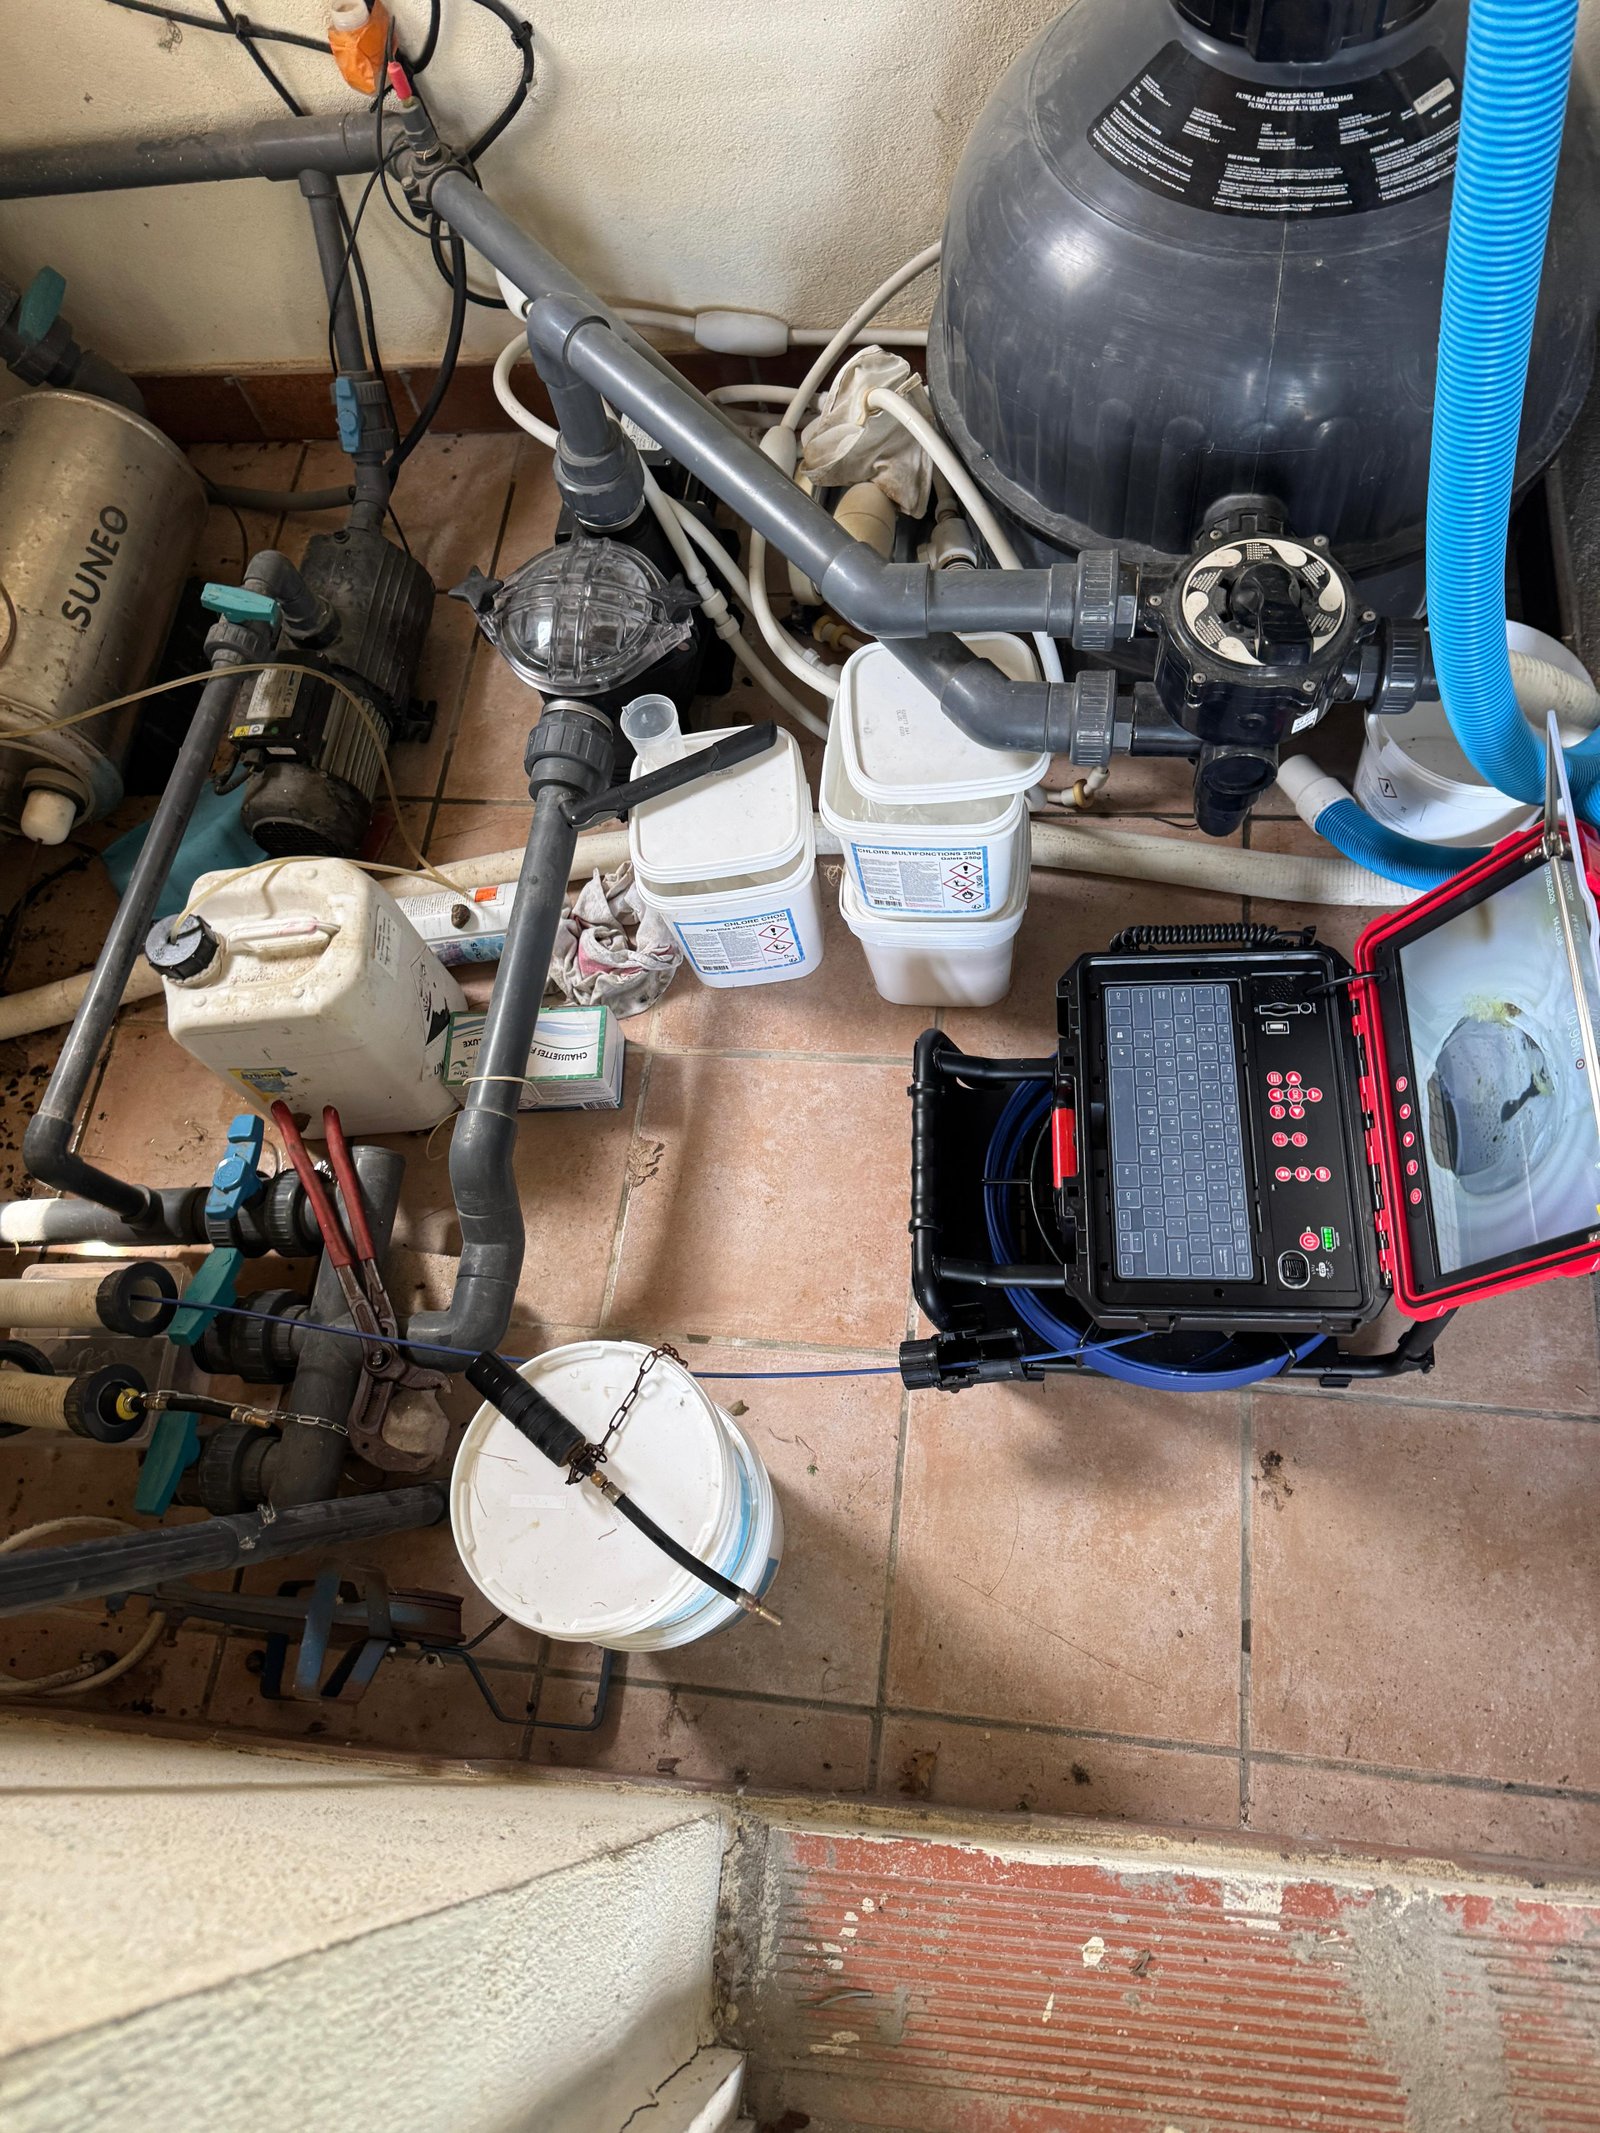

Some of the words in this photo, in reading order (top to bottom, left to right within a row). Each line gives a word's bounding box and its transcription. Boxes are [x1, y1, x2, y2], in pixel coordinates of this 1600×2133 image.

[62, 506, 128, 628] SUNEO
[724, 919, 760, 927] CHLORE
[761, 912, 786, 921] CHOC
[537, 1049, 587, 1061] CHAUSSETTES
